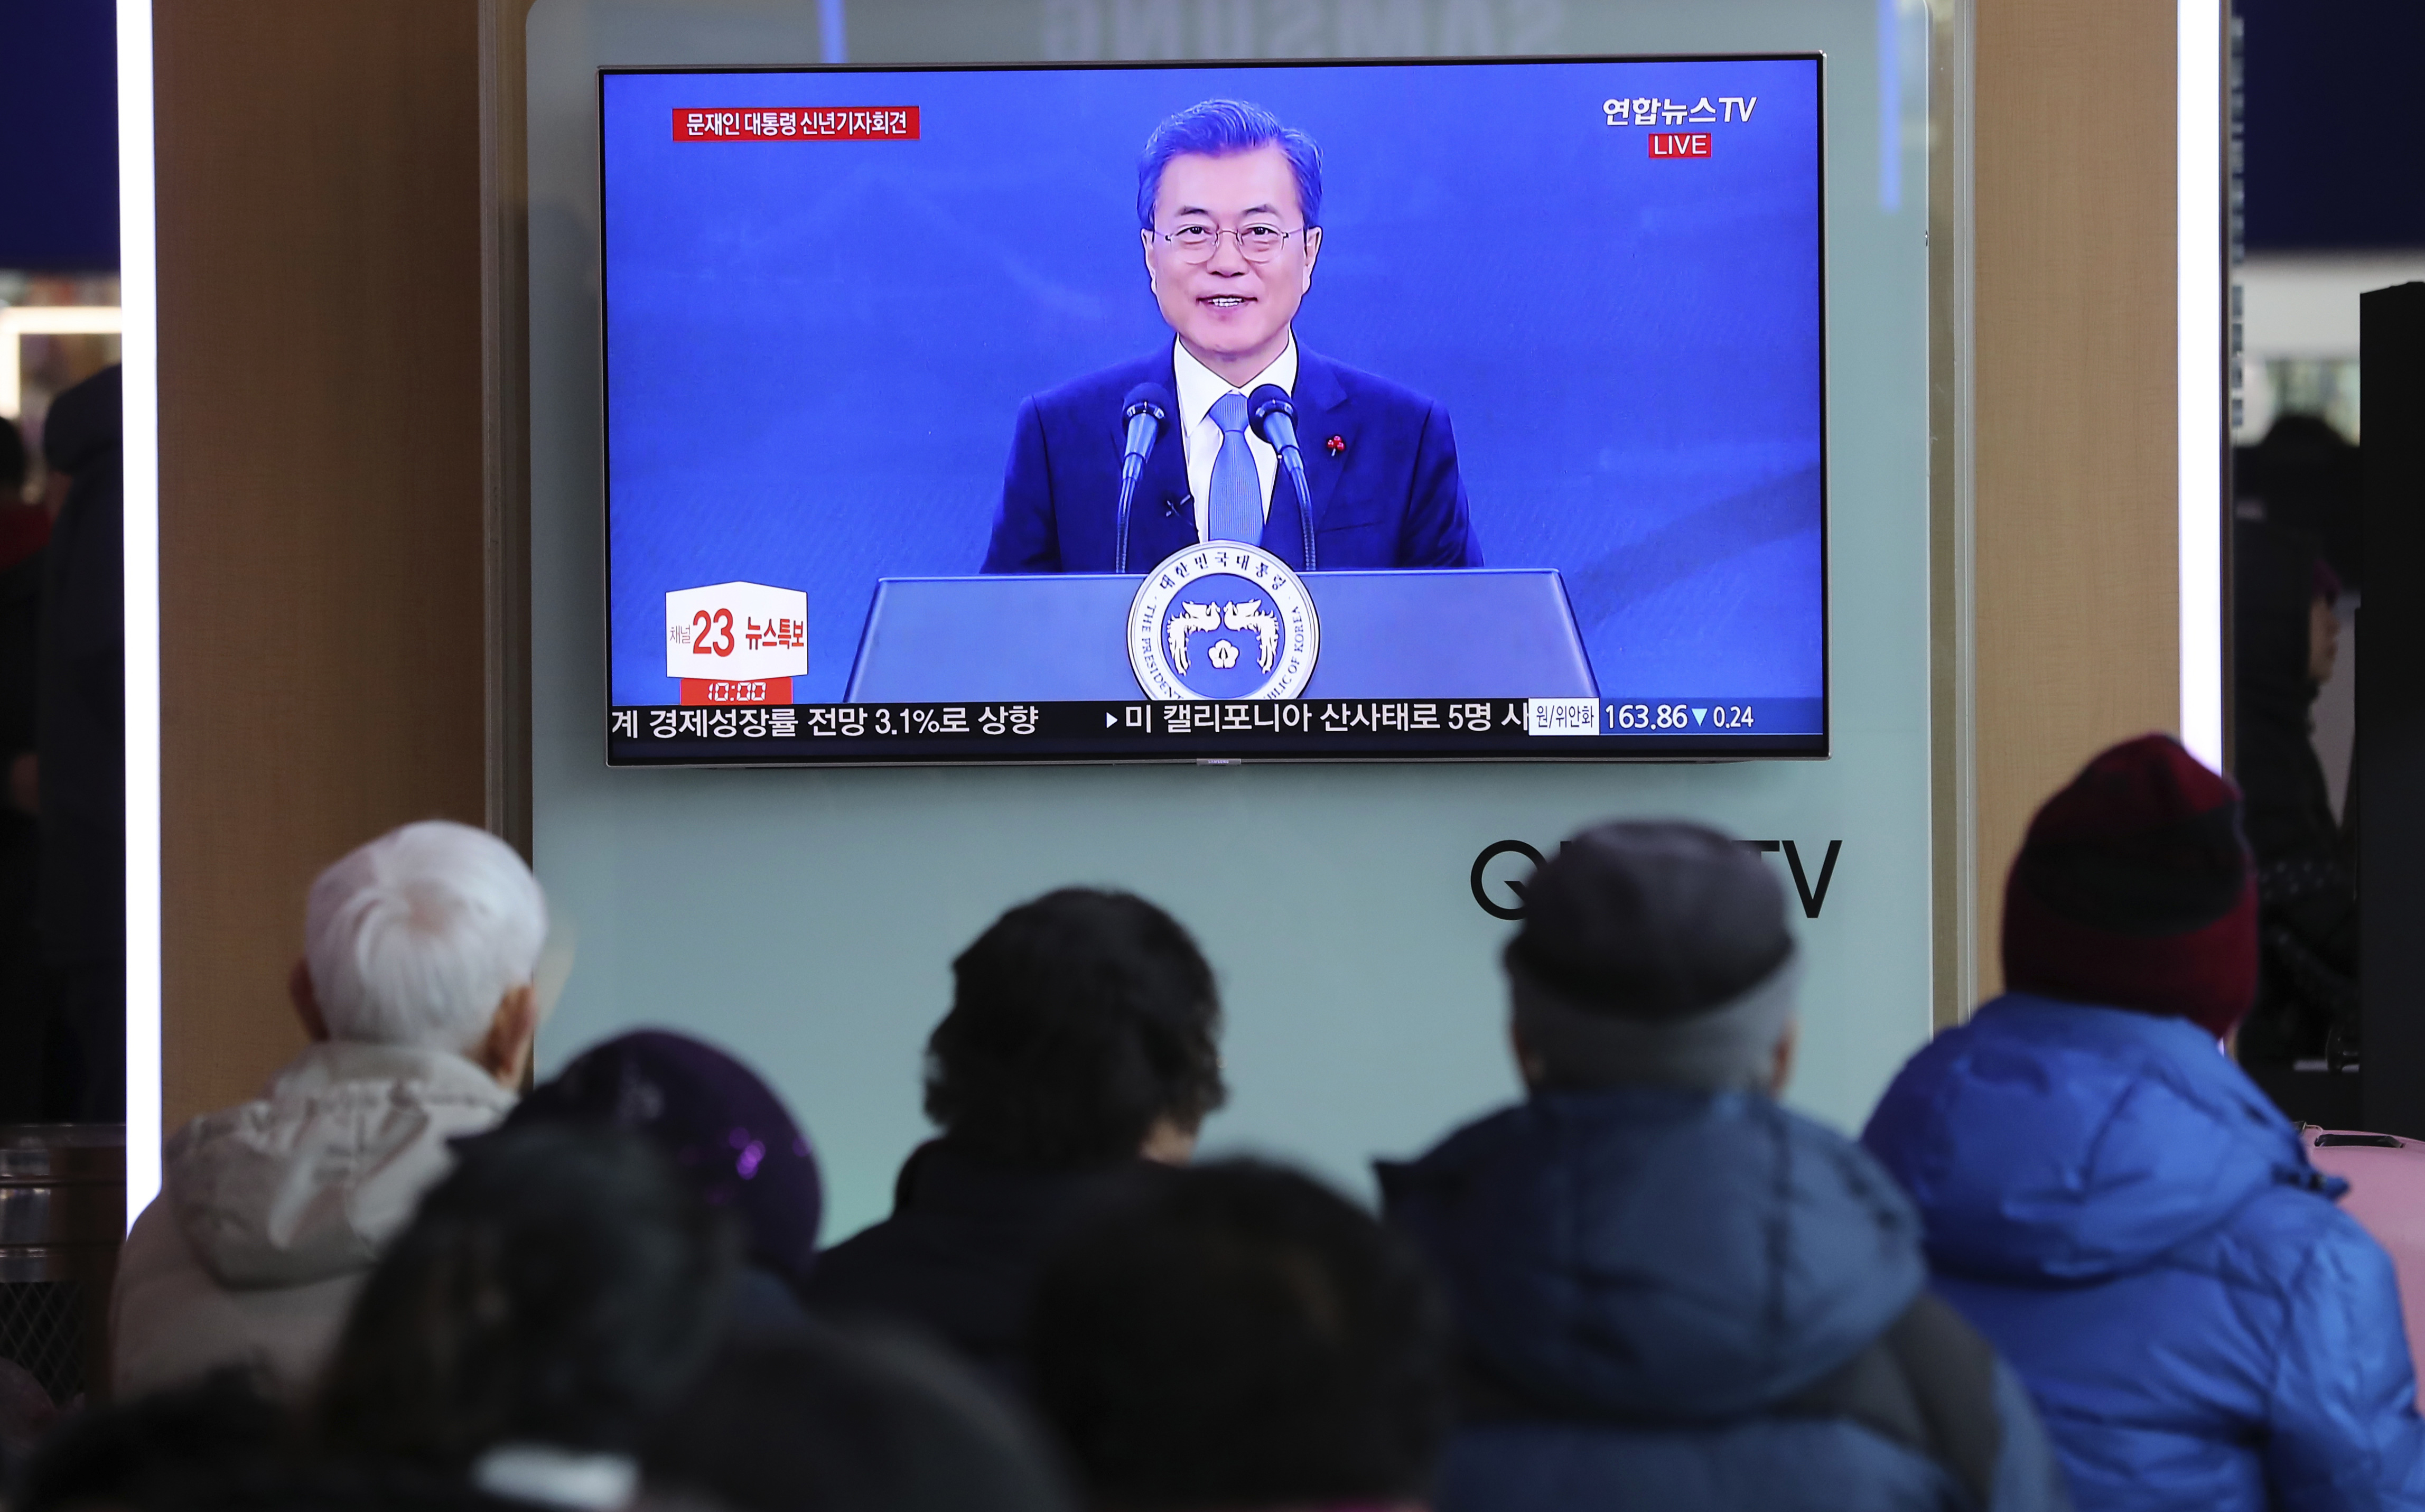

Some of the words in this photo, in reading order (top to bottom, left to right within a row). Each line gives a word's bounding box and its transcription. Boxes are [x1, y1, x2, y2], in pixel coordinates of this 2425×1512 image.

[686, 112, 740, 136] 문재인
[744, 111, 797, 135] 대통령
[800, 110, 907, 135] 신년기자회견
[1602, 97, 1758, 126] 연합뉴스TV
[1654, 134, 1707, 155] LIVE
[669, 624, 691, 645] 채널
[693, 608, 735, 657] 23
[745, 616, 805, 650] 뉴스특보
[1142, 604, 1156, 633] THE
[1288, 656, 1300, 674] OF
[707, 682, 767, 702] 10:00
[649, 708, 799, 739] 경제성장률
[807, 707, 868, 736] 전망
[875, 707, 970, 735] 3.1%로
[977, 705, 1039, 735] 상향
[1125, 704, 1152, 733] 미
[1163, 703, 1313, 733] 캘리포니아
[1320, 703, 1441, 732] 산사태로
[1448, 702, 1492, 732] 5명
[1536, 705, 1595, 729] 원/위안화
[1605, 704, 1689, 731] 163.86
[1712, 705, 1755, 729] 0.24
